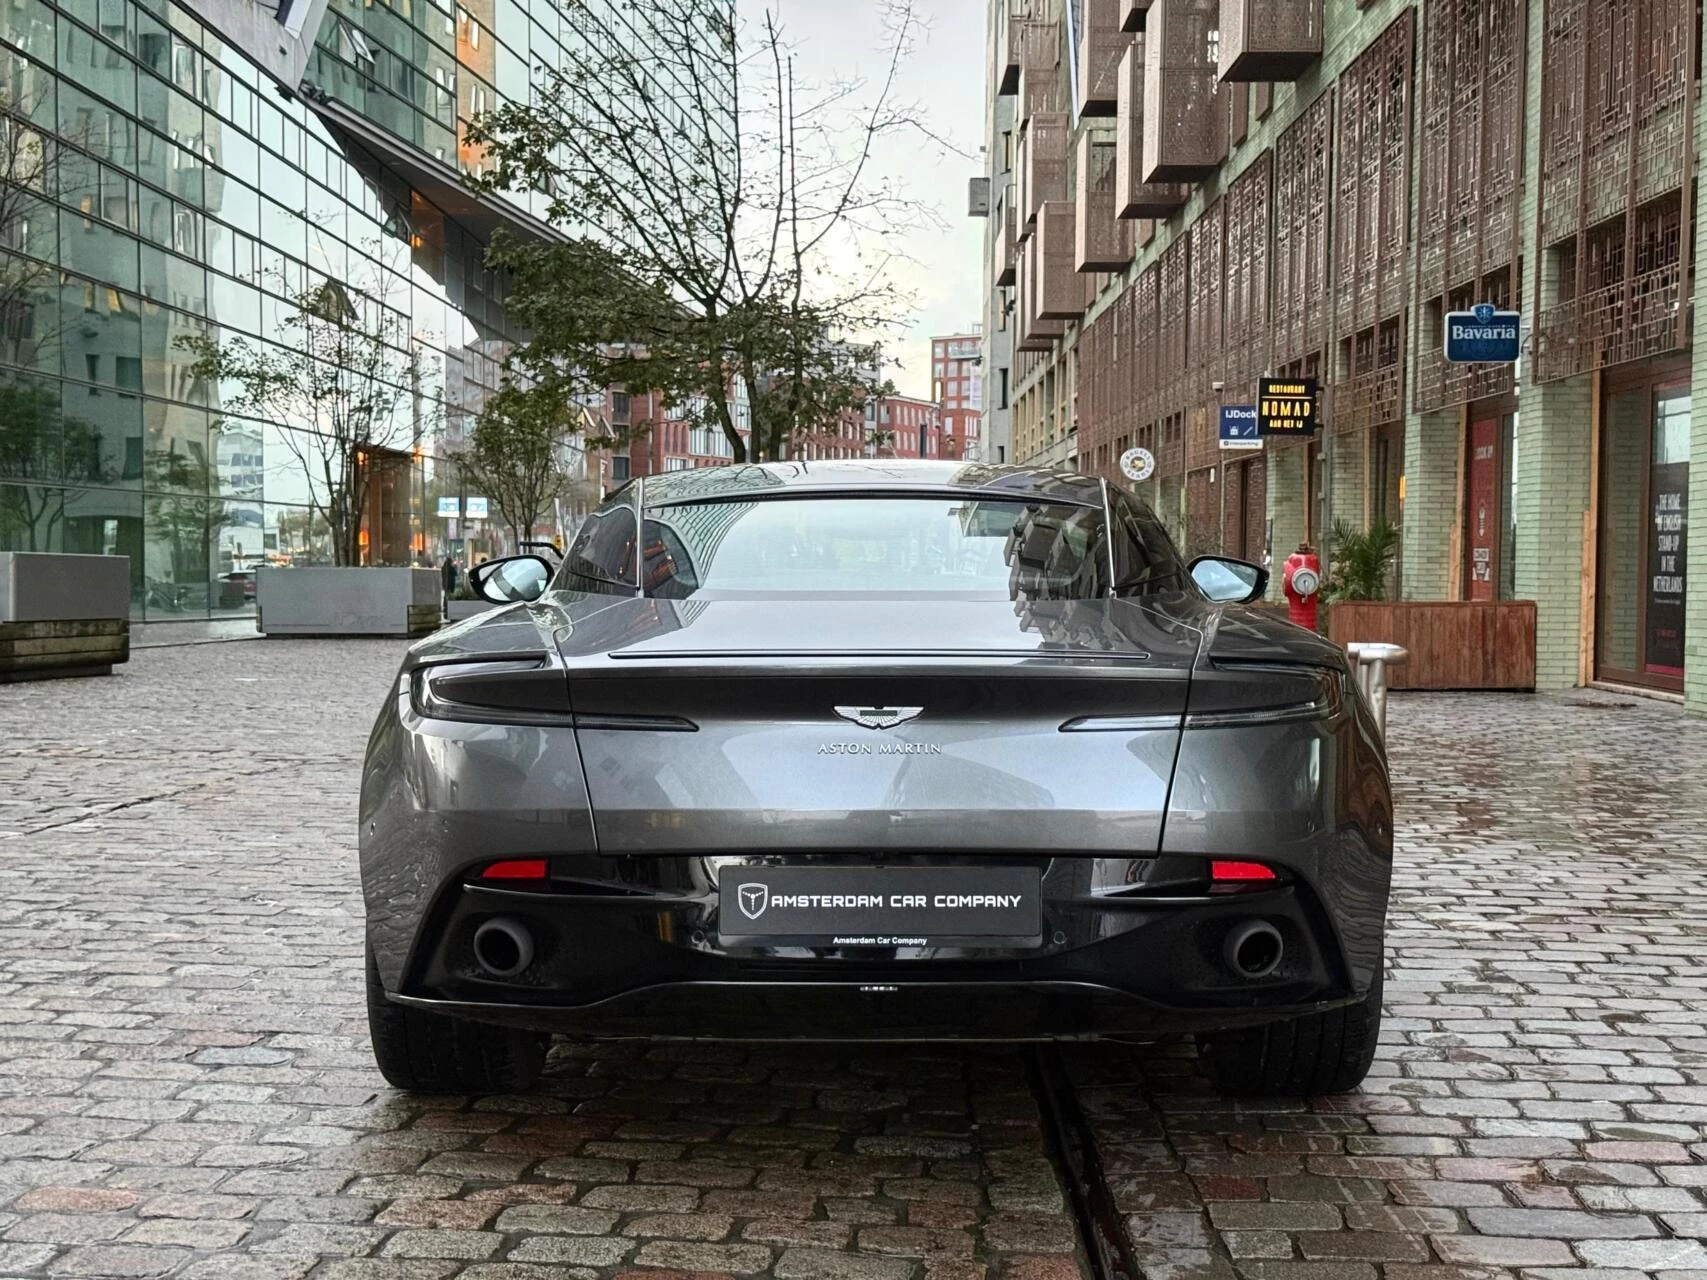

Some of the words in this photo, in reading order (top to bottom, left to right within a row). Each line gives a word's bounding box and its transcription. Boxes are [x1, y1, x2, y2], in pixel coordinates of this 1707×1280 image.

[1452, 325, 1516, 340] Bavaria
[1269, 384, 1306, 394] RESTAURANT
[1225, 409, 1258, 419] IJDock
[1262, 401, 1311, 417] NOMAD
[1659, 494, 1667, 510] THE
[1668, 494, 1680, 510] HOME
[1664, 514, 1681, 531] ENGLISH
[1658, 535, 1679, 552] STAND-UP
[1661, 555, 1666, 572] IN
[1667, 555, 1675, 572] THE
[1653, 575, 1683, 593] NETHERLANDS
[818, 743, 872, 754] ASTON
[879, 743, 942, 754] MARTIN
[771, 895, 883, 908] AMSTERDAM
[890, 895, 927, 908] CAR
[934, 895, 1022, 908] COMPANY
[833, 936, 876, 945] Amsterdam
[877, 936, 890, 945] Car
[892, 936, 927, 947] Company
